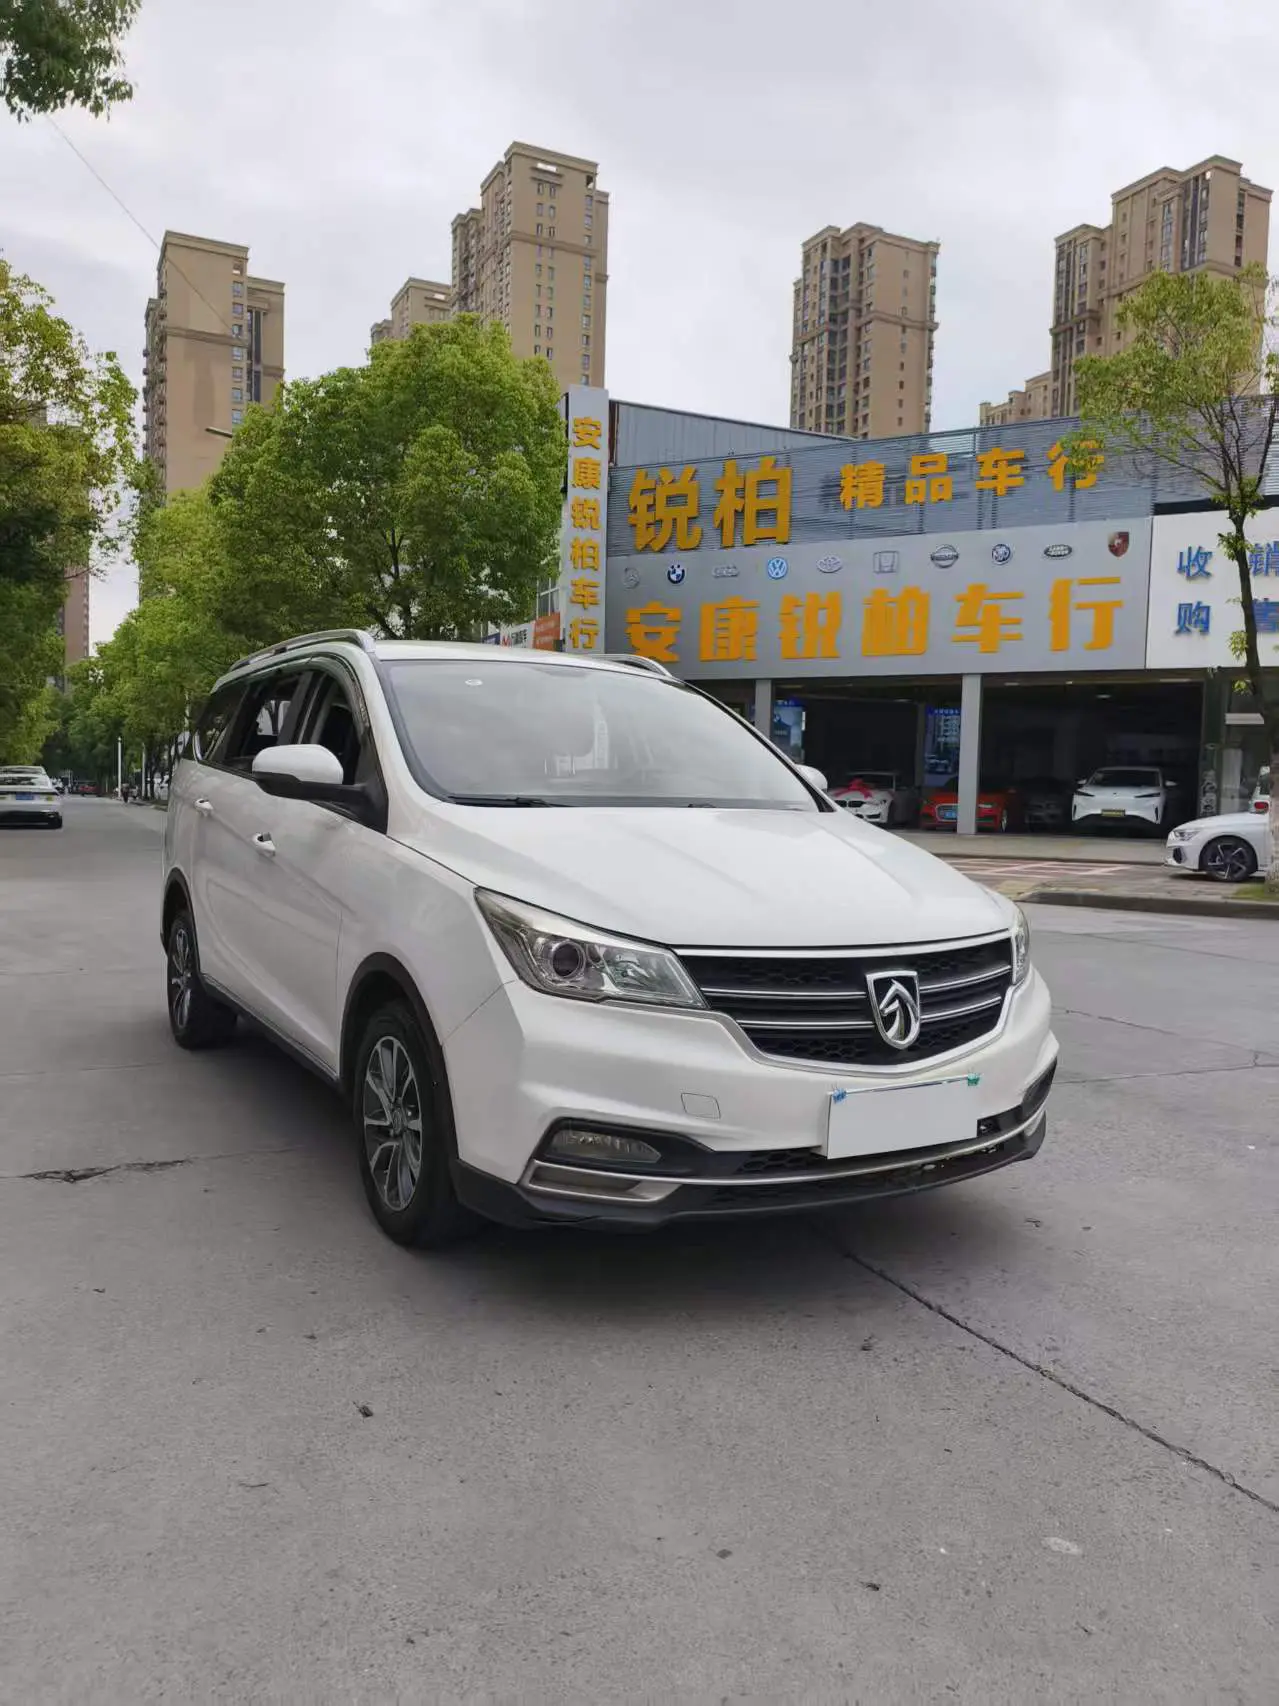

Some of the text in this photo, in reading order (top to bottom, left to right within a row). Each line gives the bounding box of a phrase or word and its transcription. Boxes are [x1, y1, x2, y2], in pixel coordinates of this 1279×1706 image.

[569, 416, 601, 649] 安康锐柏车行
[627, 438, 1105, 552] 锐柏 精品车行
[624, 576, 1123, 662] 安康锐柏车行
[1175, 546, 1213, 634] 收购
